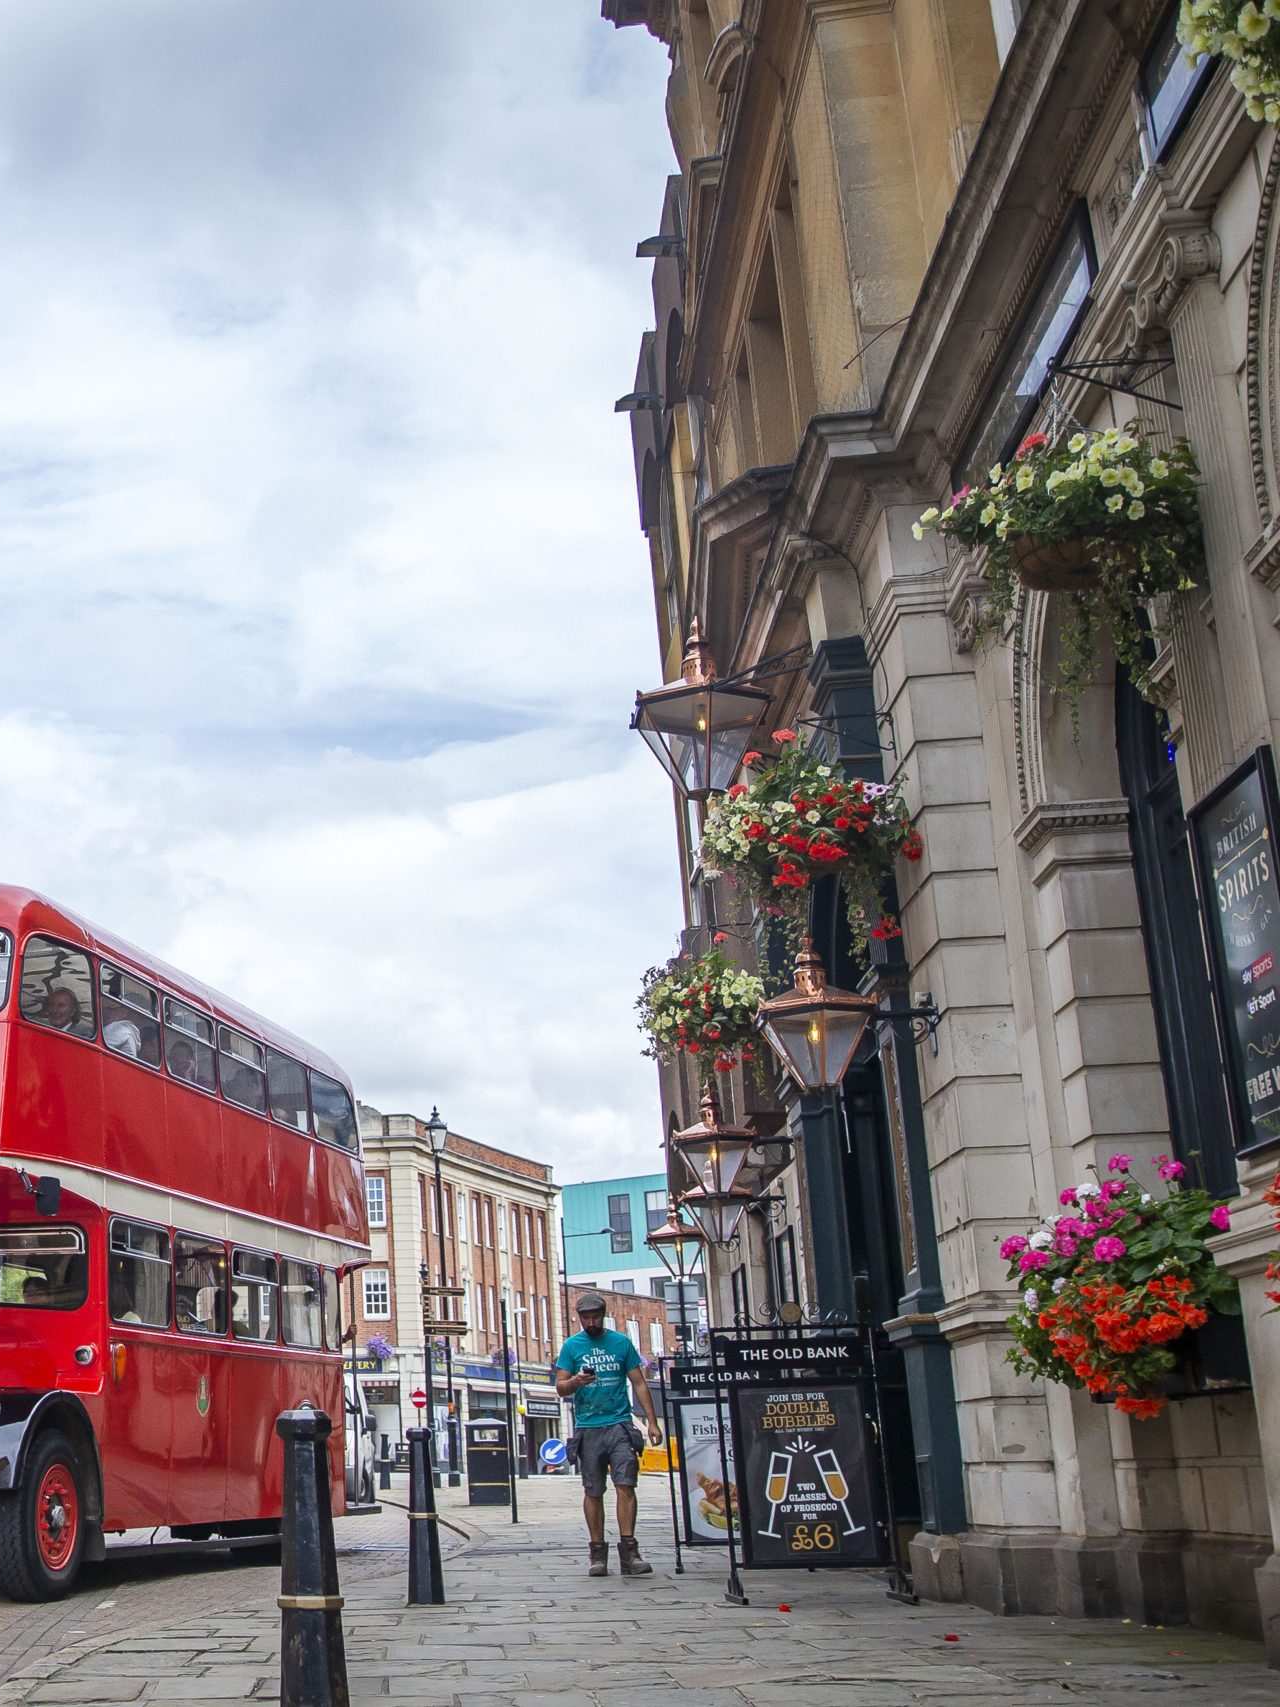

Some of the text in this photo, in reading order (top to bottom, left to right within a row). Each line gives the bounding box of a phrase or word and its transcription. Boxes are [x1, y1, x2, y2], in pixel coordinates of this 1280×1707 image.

[1216, 812, 1257, 859] BRITISH
[1218, 851, 1270, 913] SPIRITS
[1242, 957, 1273, 985] sky sports
[1249, 988, 1276, 1015] BT Sport
[1245, 1070, 1274, 1105] FREE
[591, 1347, 606, 1355] The
[740, 1346, 849, 1361] THE OLD BANK
[582, 1354, 616, 1365] Snow
[682, 1373, 706, 1384] THE
[767, 1392, 825, 1403] JOIN US FOR
[765, 1400, 830, 1416] DOUBLE
[762, 1414, 836, 1429] BUBBLES
[692, 1424, 718, 1436] Fish
[796, 1483, 816, 1491] TWO
[788, 1493, 827, 1502] GLASSES
[780, 1503, 838, 1513] OF PROSECCO
[791, 1524, 835, 1551] £6
